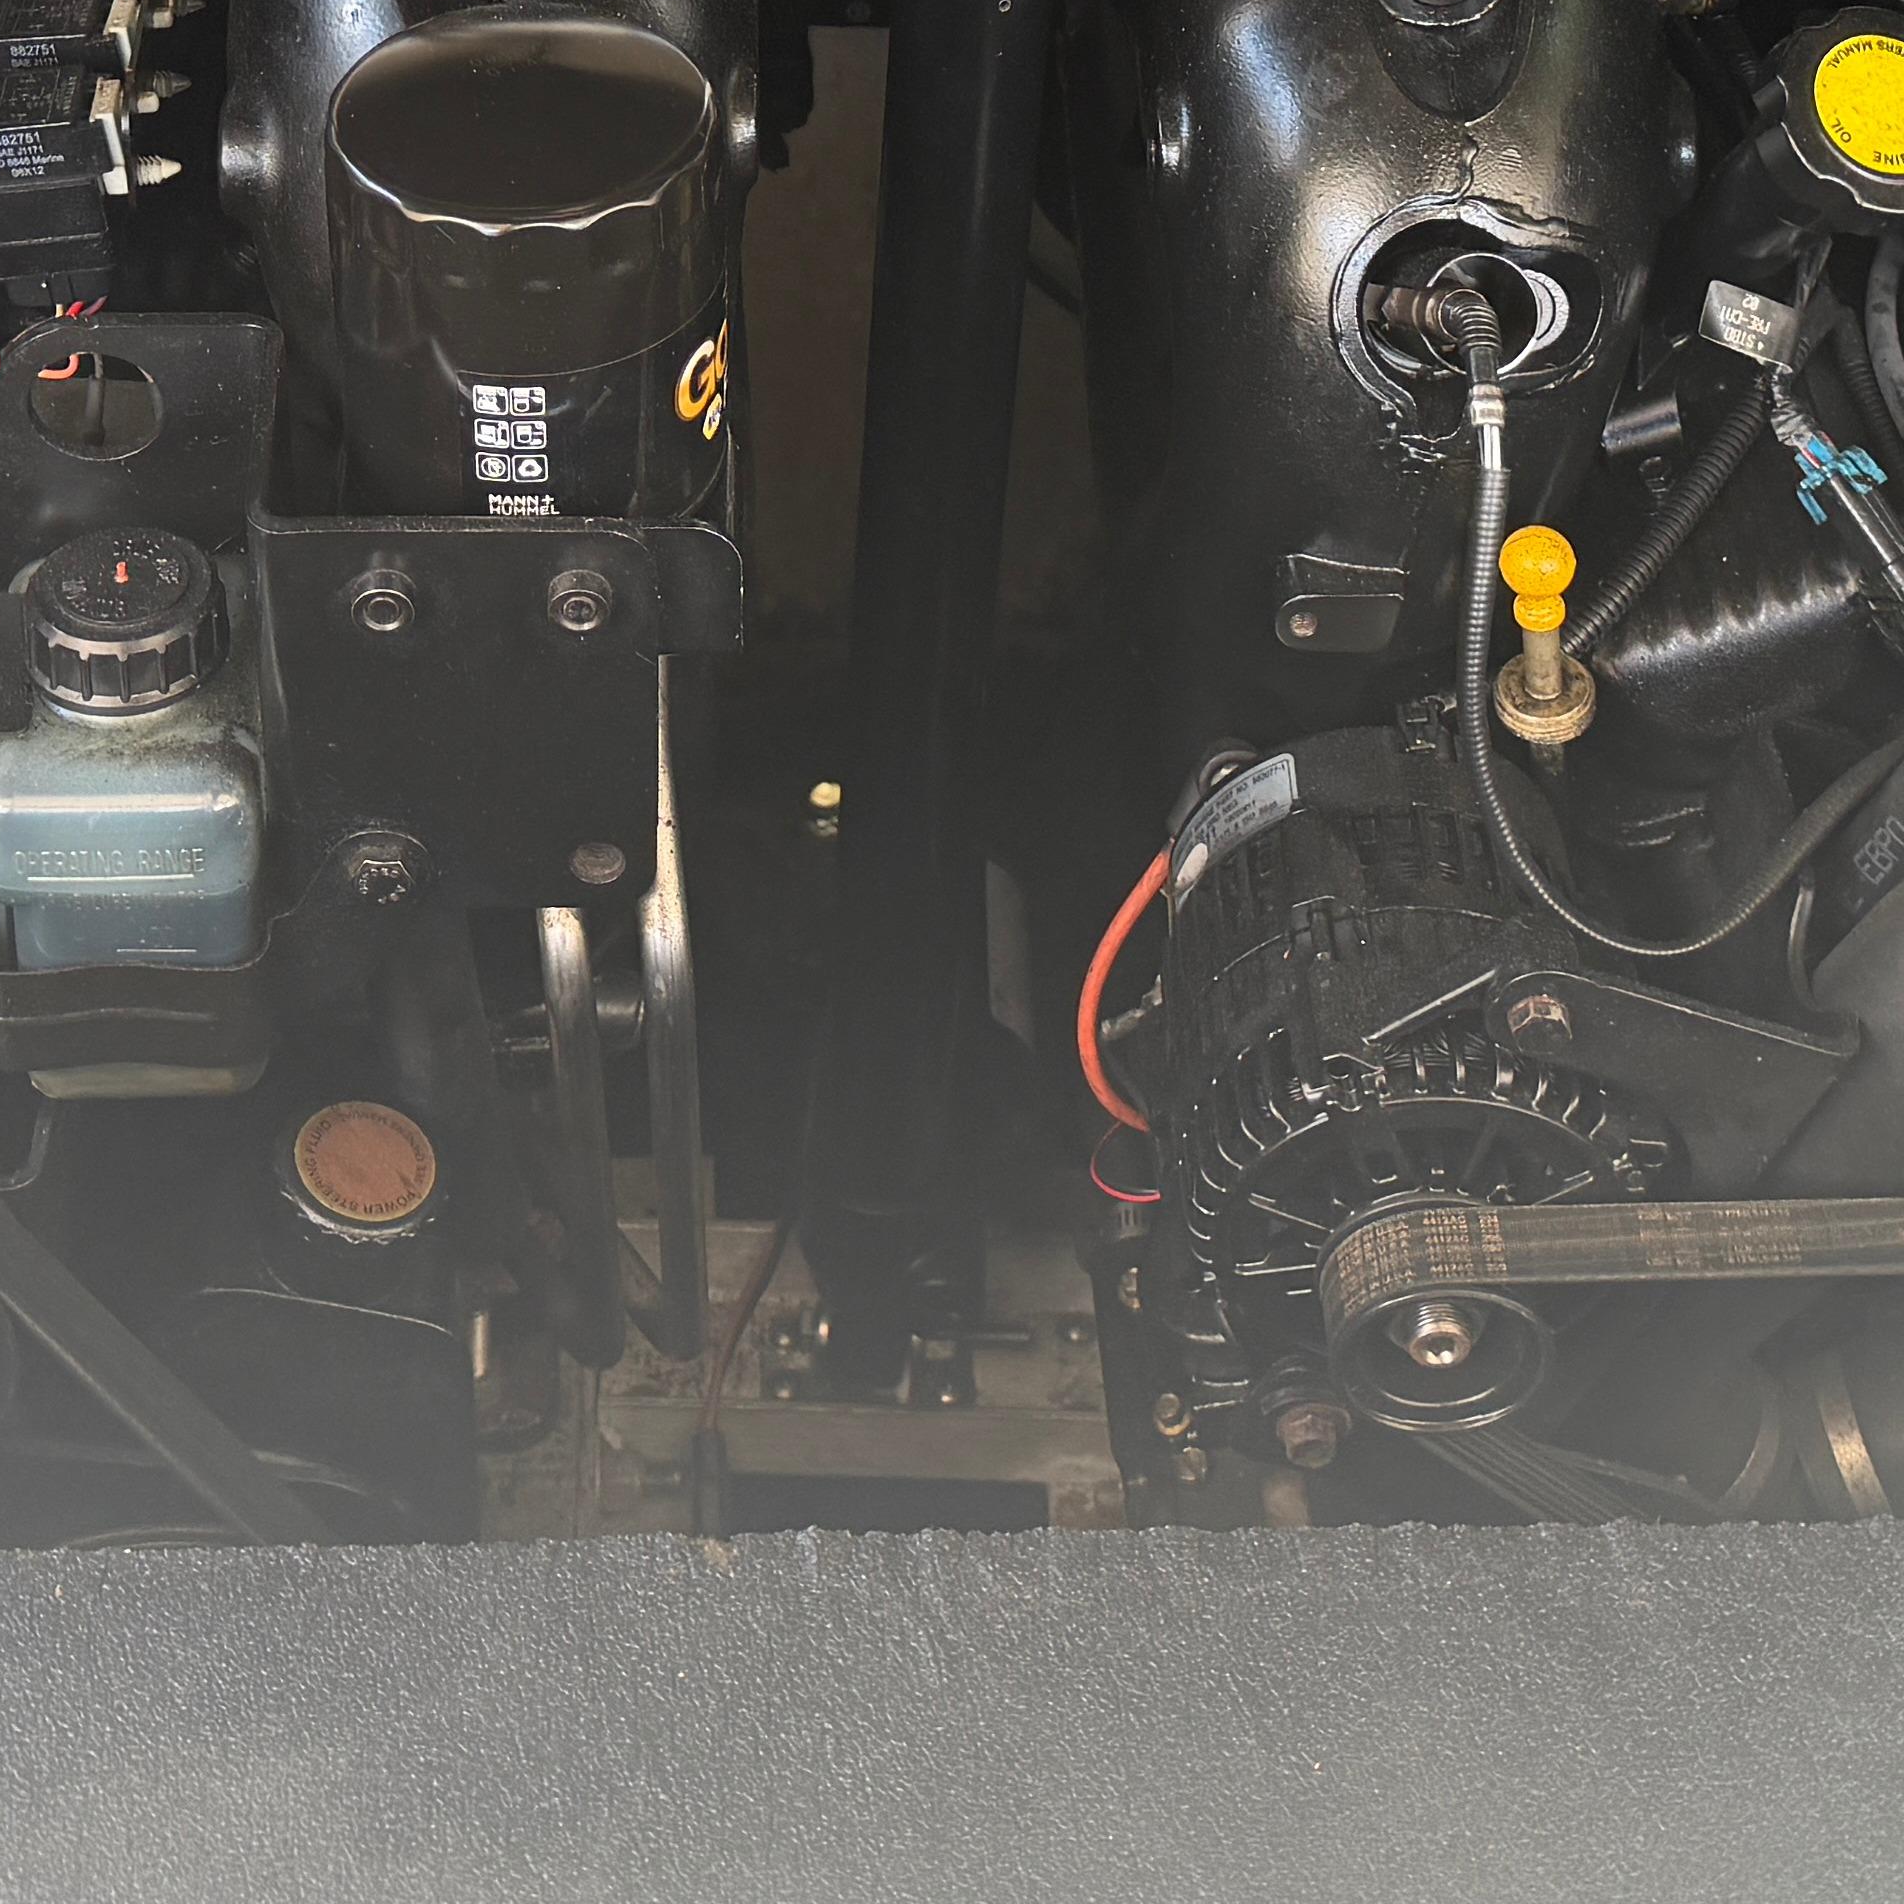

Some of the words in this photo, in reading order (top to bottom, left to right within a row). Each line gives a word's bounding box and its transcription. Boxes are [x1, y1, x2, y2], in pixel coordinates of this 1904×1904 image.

[10, 44, 56, 56] 882751
[1826, 40, 1873, 68] MANUAL
[1831, 118, 1851, 144] OIL
[489, 504, 560, 516] HUMMEL
[15, 849, 123, 875] OPERATING
[139, 847, 205, 873] RANGE
